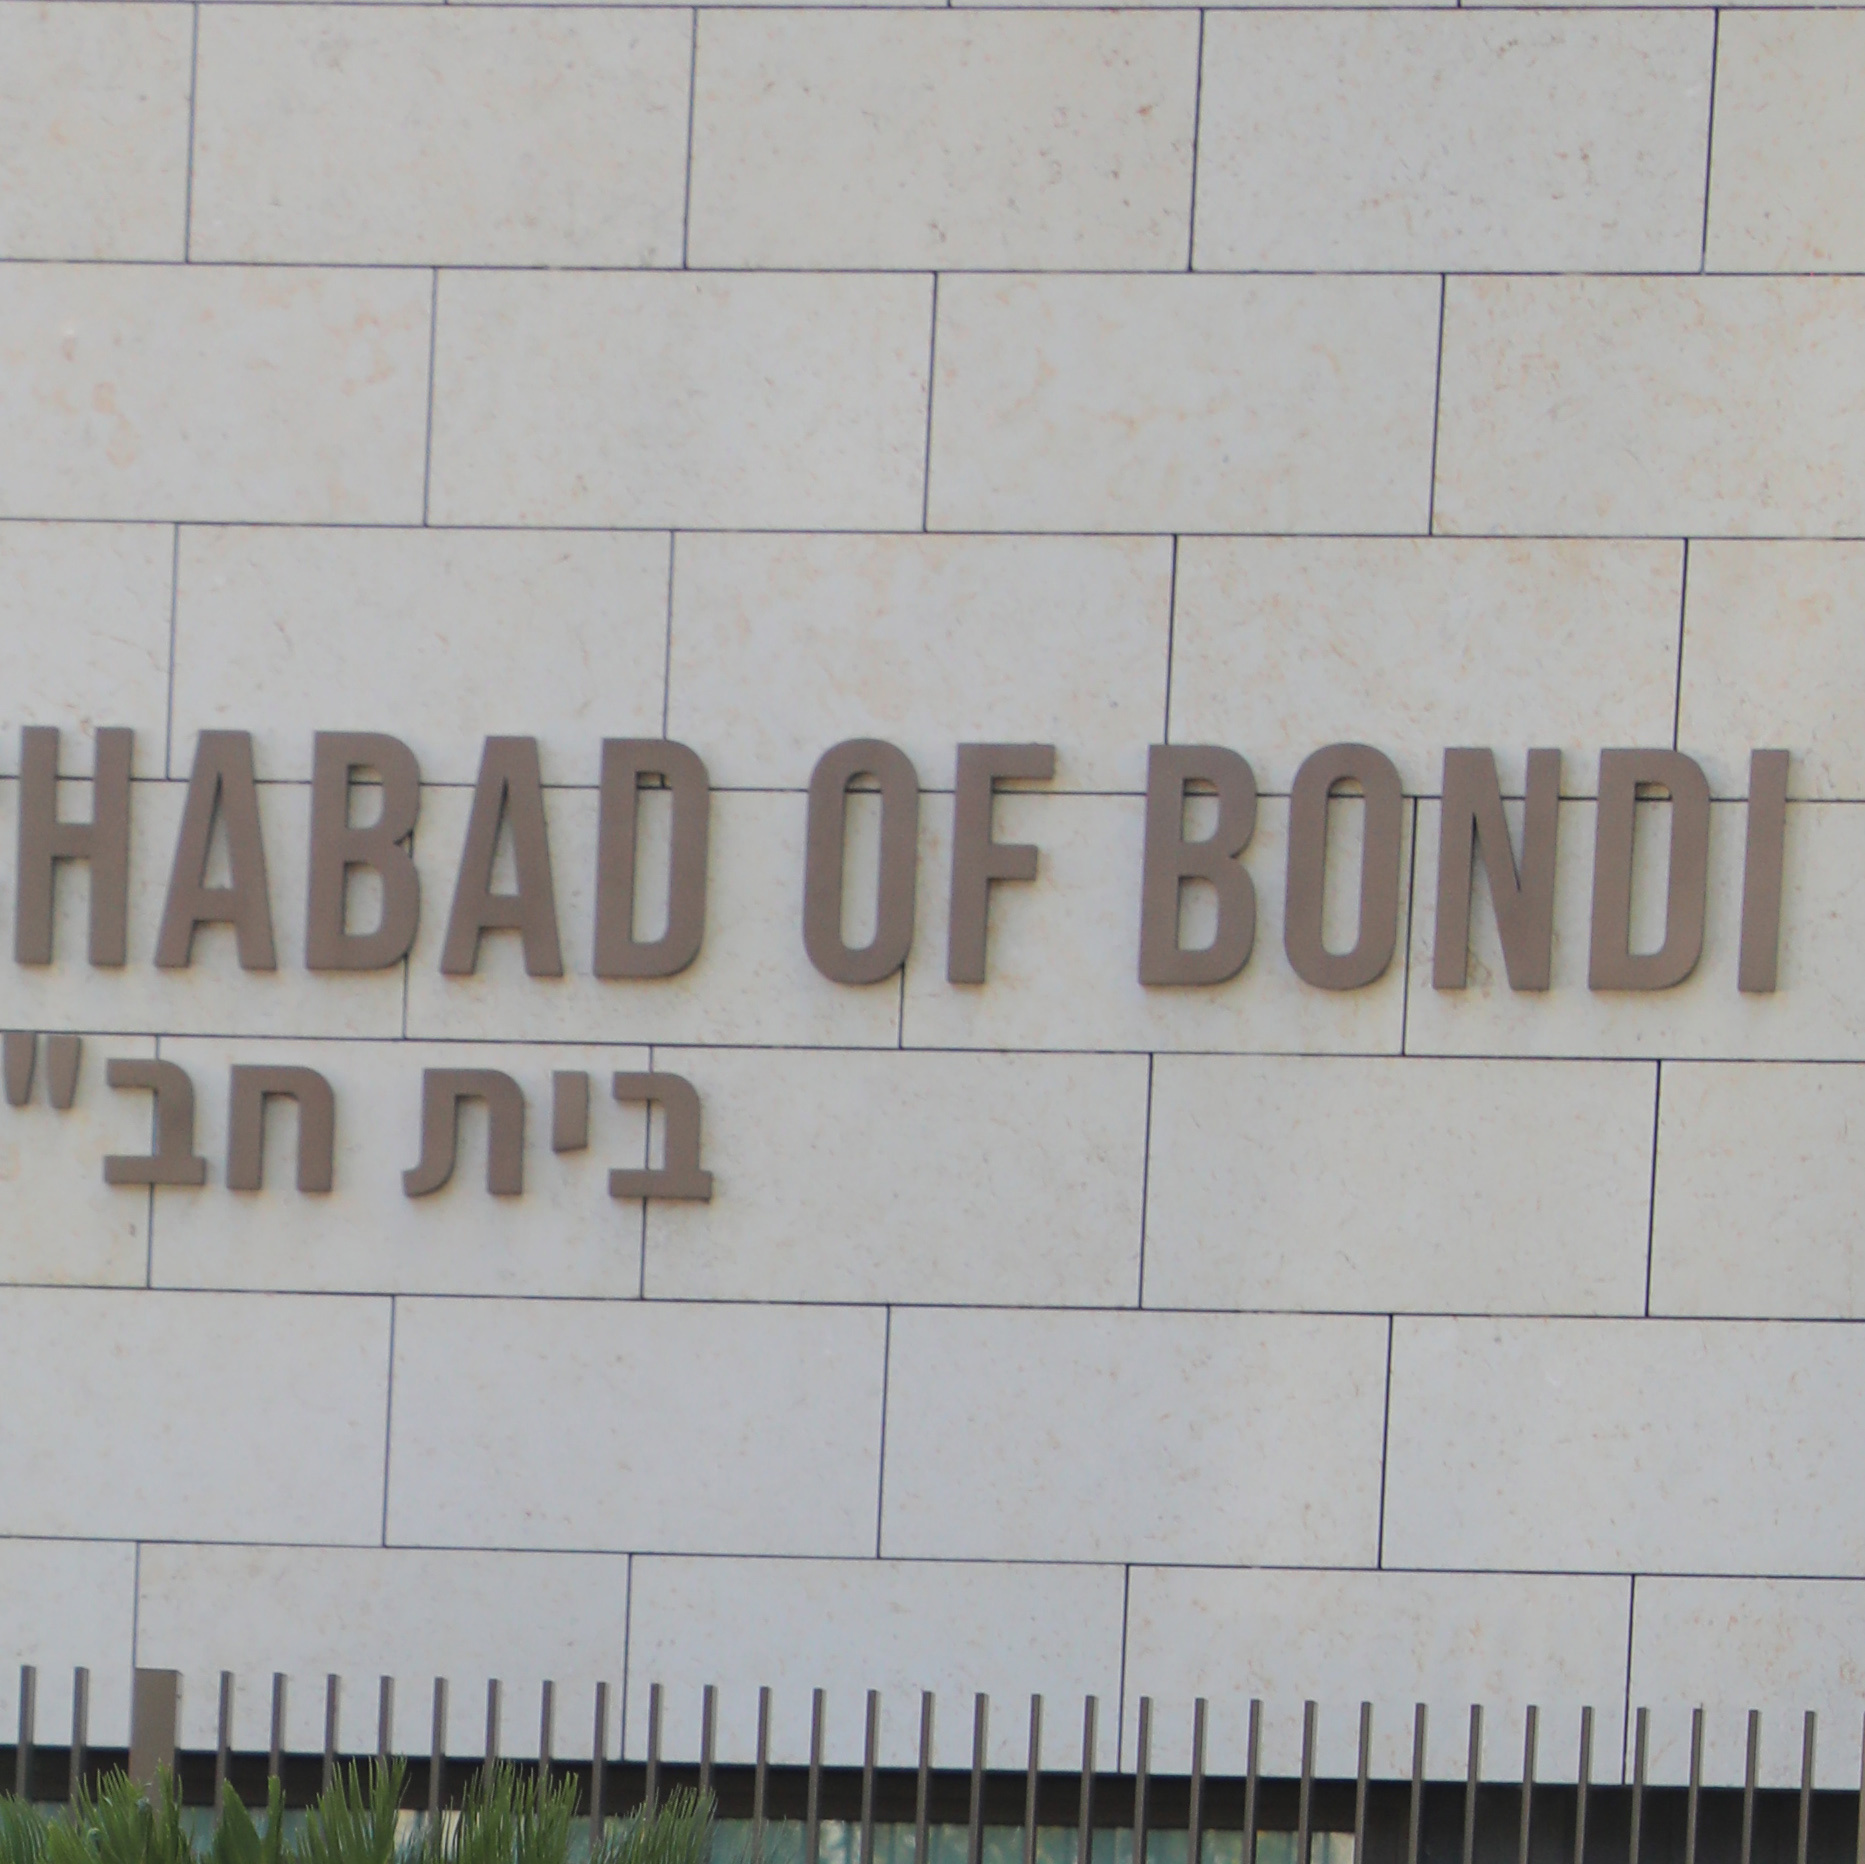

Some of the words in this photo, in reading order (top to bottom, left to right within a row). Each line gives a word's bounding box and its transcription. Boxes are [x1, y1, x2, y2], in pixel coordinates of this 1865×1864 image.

[800, 736, 1059, 993] OF
[1136, 741, 1795, 999] BONDI
[401, 1066, 717, 1211] בית
